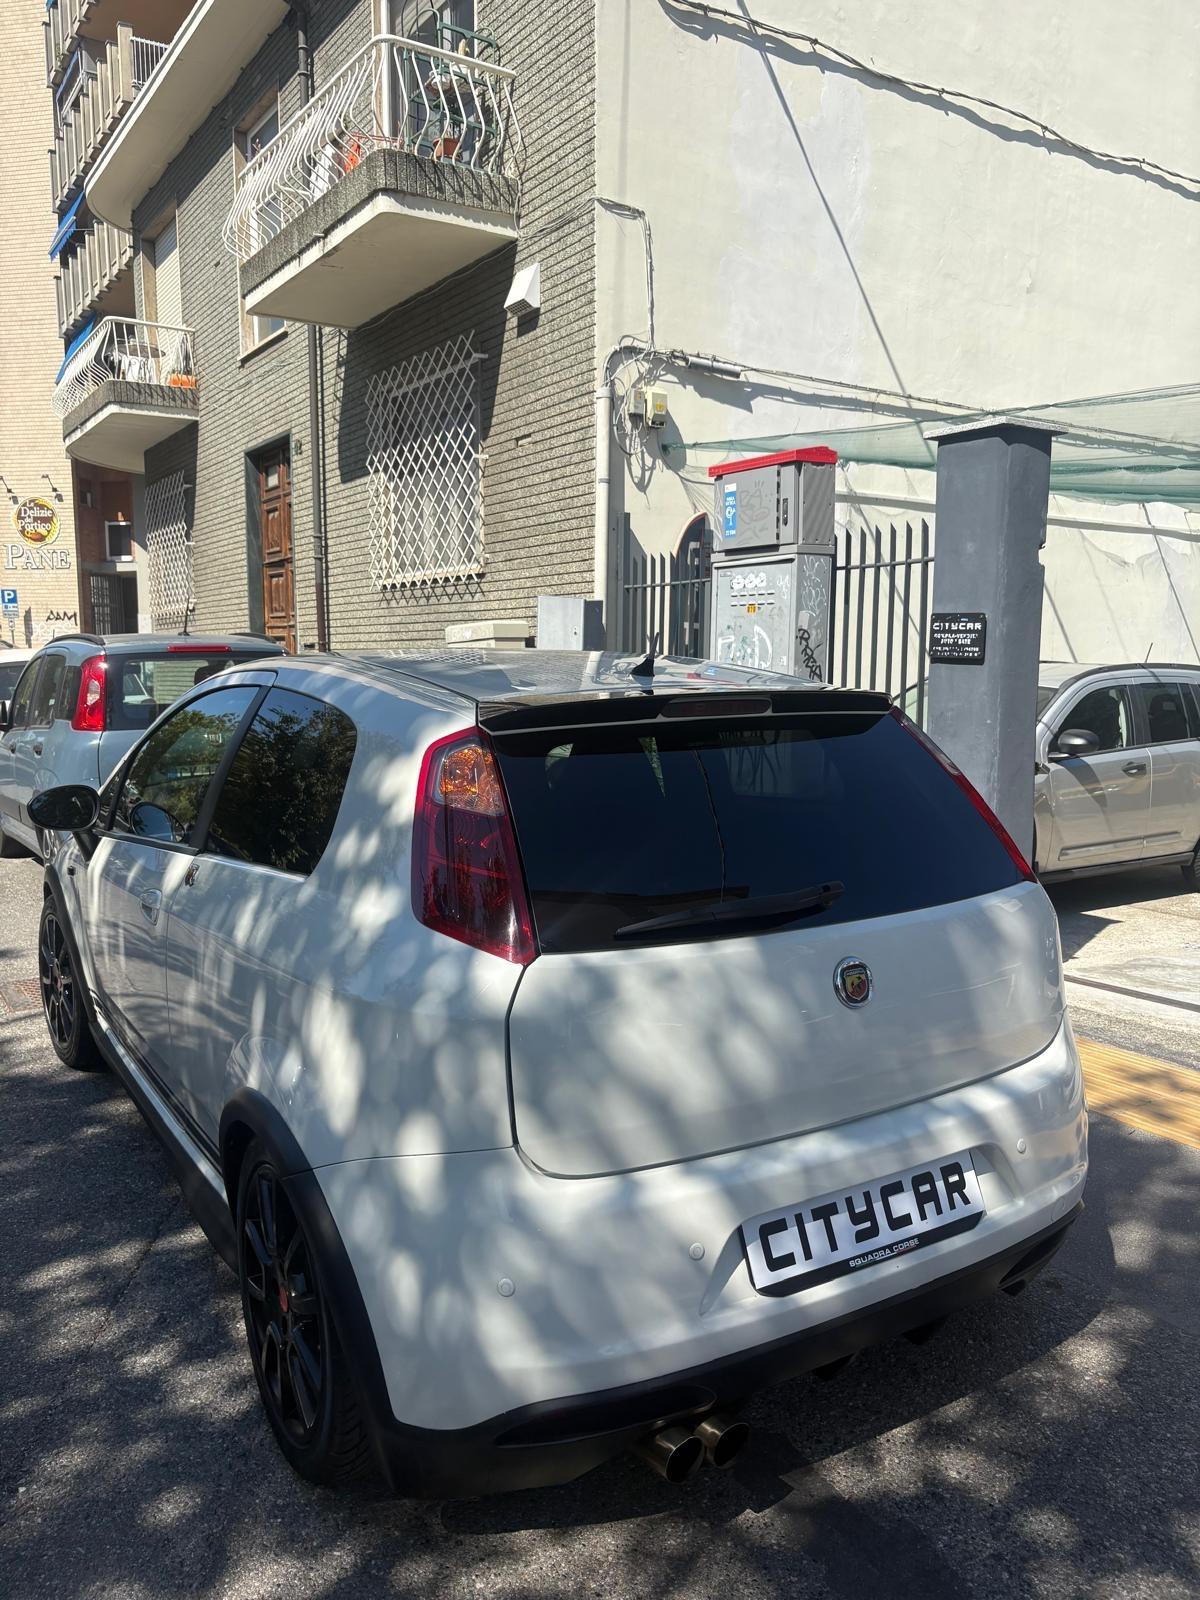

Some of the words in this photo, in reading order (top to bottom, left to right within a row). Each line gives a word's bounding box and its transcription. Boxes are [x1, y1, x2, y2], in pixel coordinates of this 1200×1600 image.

[21, 507, 53, 518] Delizie
[24, 515, 34, 523] del
[18, 520, 52, 532] Portico
[3, 590, 15, 603] P
[758, 1161, 971, 1273] CITYCAR
[849, 1248, 892, 1268] SQUADRA
[892, 1238, 920, 1253] CORSE
